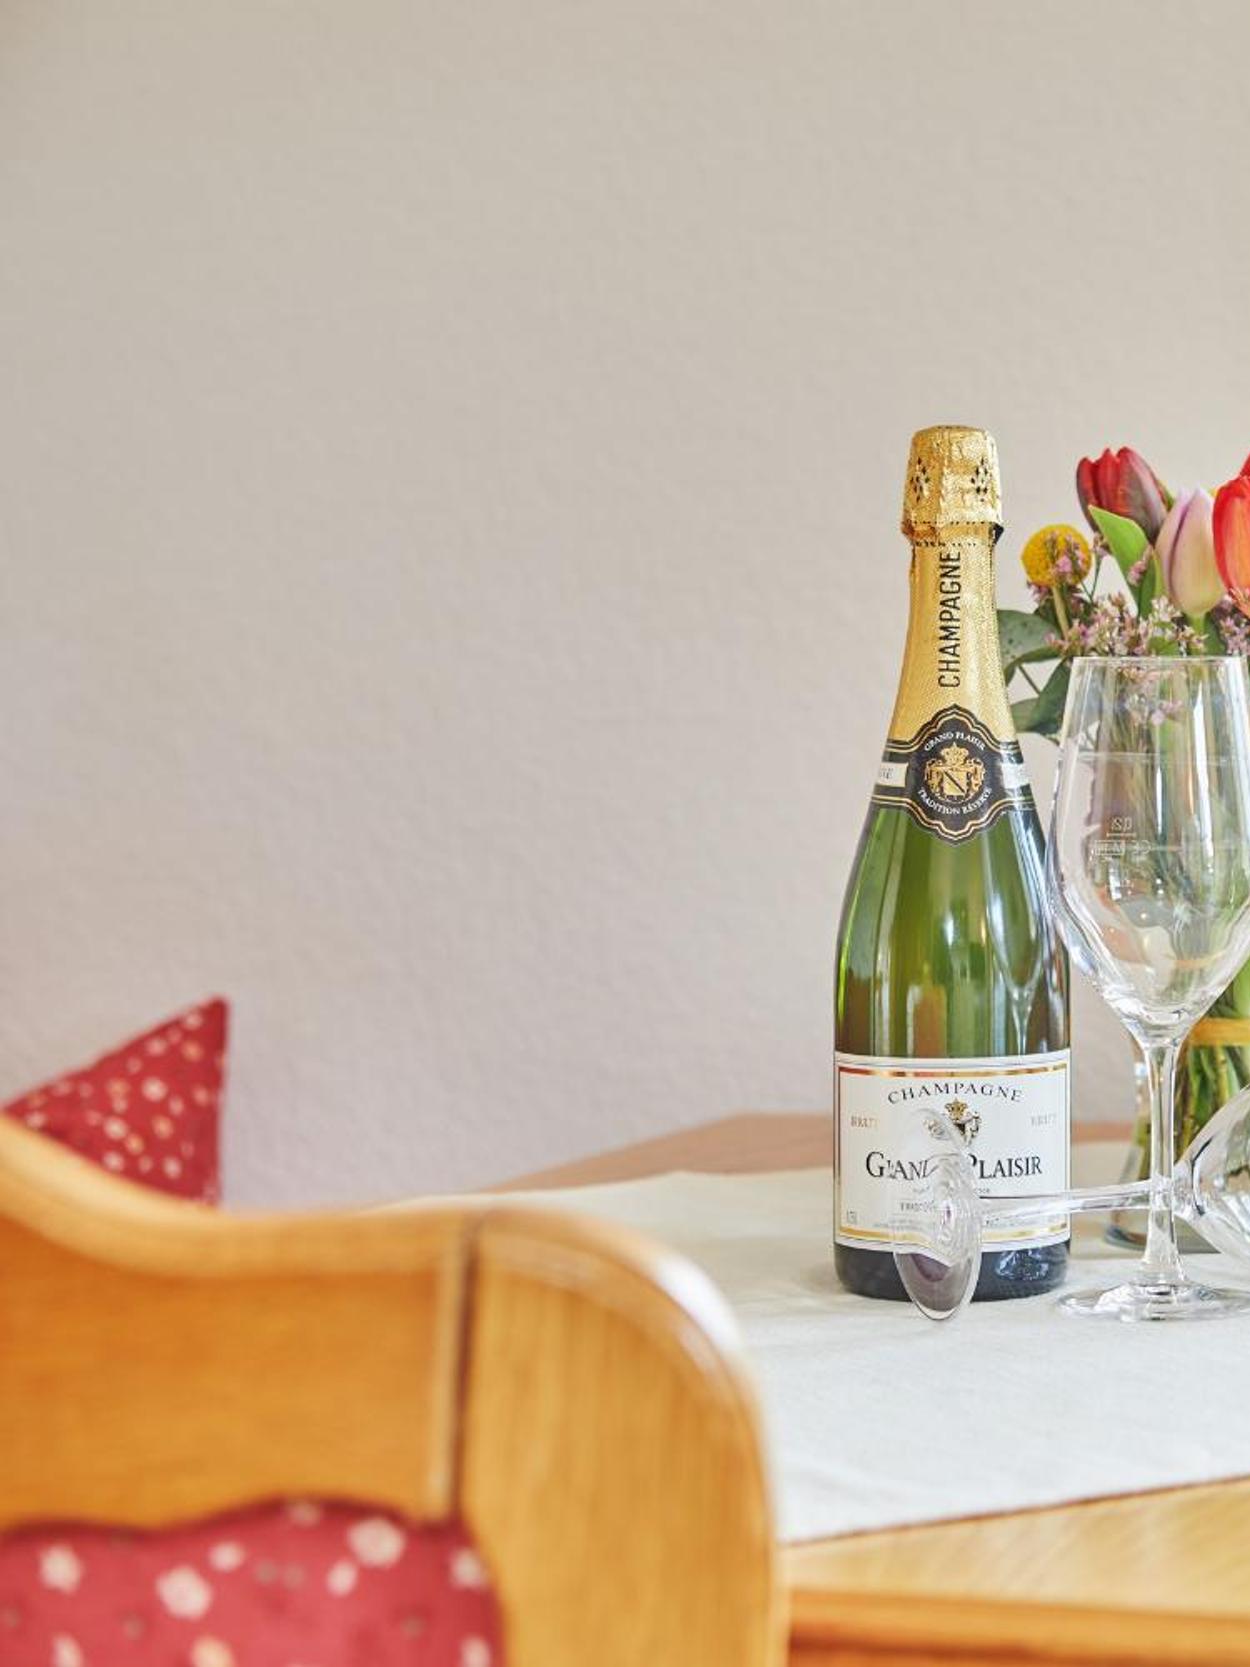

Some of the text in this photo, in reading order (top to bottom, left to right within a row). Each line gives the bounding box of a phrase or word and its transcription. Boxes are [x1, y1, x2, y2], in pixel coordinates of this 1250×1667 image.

[938, 552, 962, 688] CHAMPAGNE
[924, 731, 954, 752] GRAND
[918, 787, 960, 814] TRADITION
[887, 1083, 1023, 1104] CHAMPAGNE
